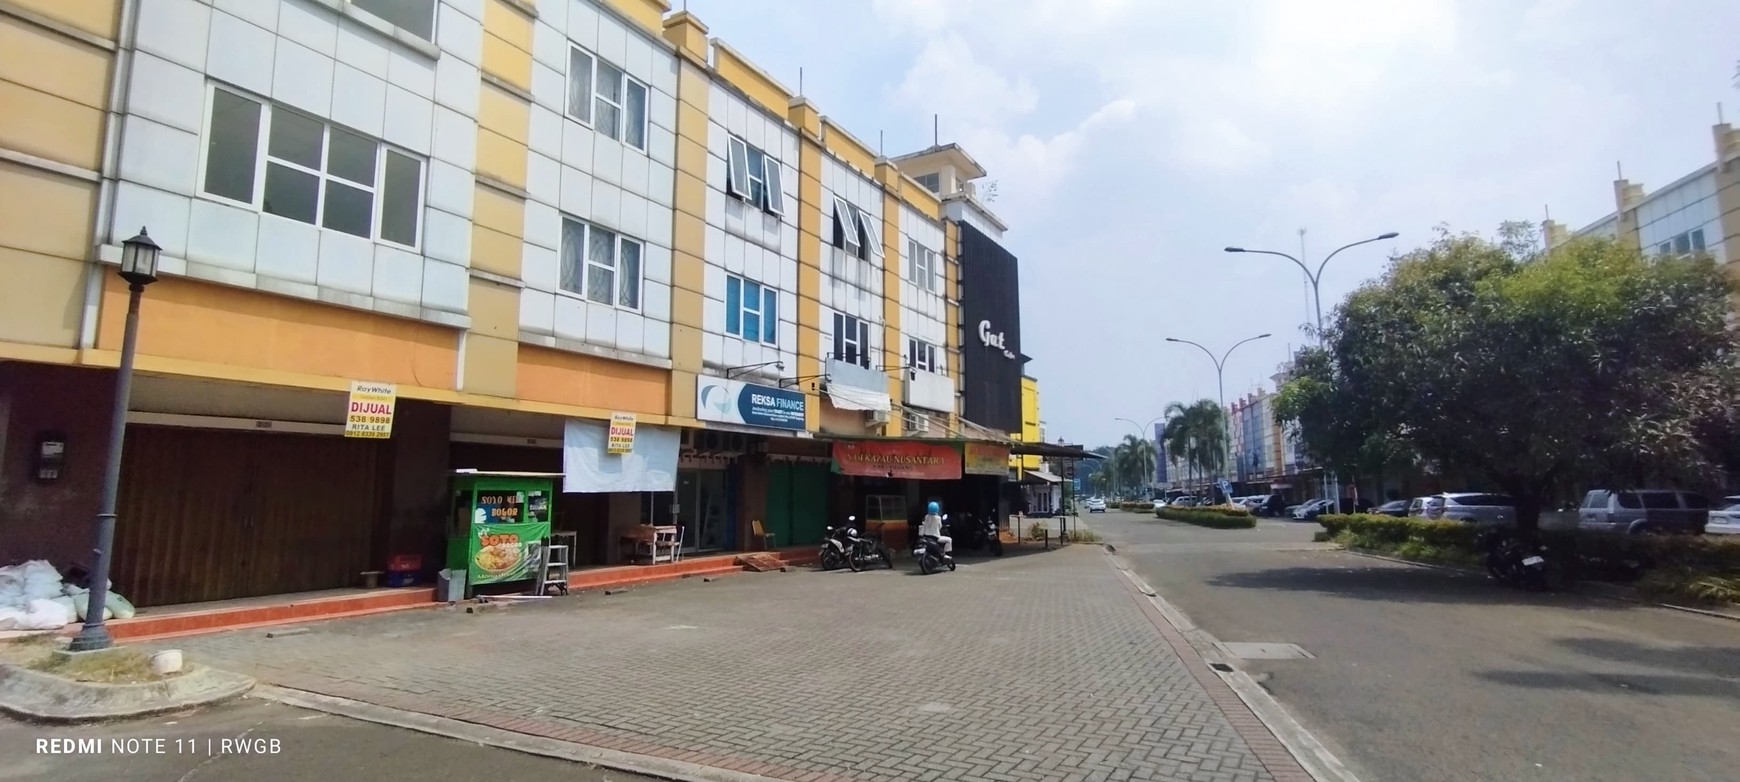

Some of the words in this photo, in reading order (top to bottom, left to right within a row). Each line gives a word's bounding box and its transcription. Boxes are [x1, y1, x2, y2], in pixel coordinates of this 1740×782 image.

[751, 393, 776, 407] REKSA
[776, 397, 804, 411] FINANCE
[351, 402, 392, 415] DIJUAL
[350, 415, 366, 423] 538
[370, 416, 391, 424] 9898
[611, 427, 634, 436] DIJUAL
[865, 453, 892, 463] KAPAU
[894, 454, 945, 465] NUSANTARA
[491, 508, 518, 517] BOGOR
[481, 534, 519, 547] SOTO
